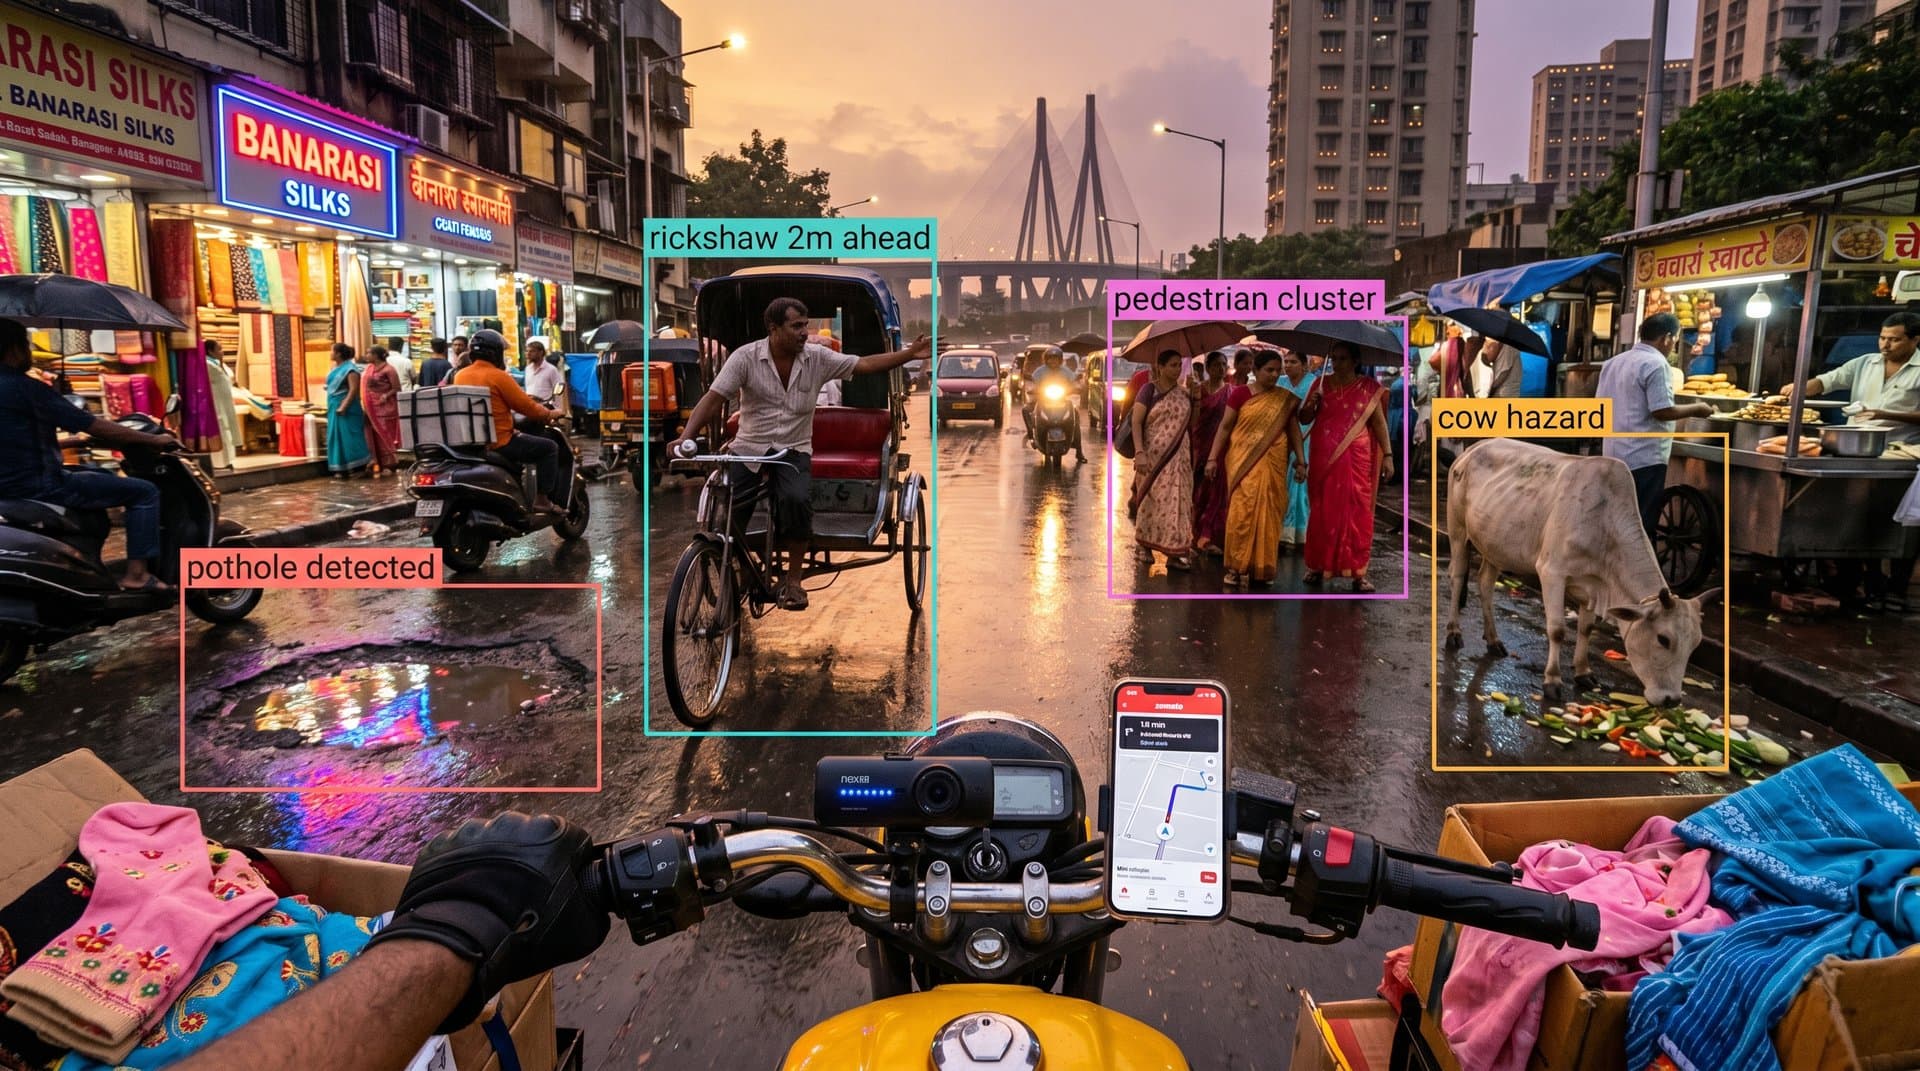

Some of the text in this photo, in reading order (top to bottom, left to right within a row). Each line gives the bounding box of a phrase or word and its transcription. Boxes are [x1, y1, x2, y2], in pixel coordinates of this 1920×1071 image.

[9, 84, 175, 146] BANARASI SILKS
[108, 57, 195, 120] SILKS
[235, 112, 382, 192] BANARASI
[285, 179, 351, 217] SILKS
